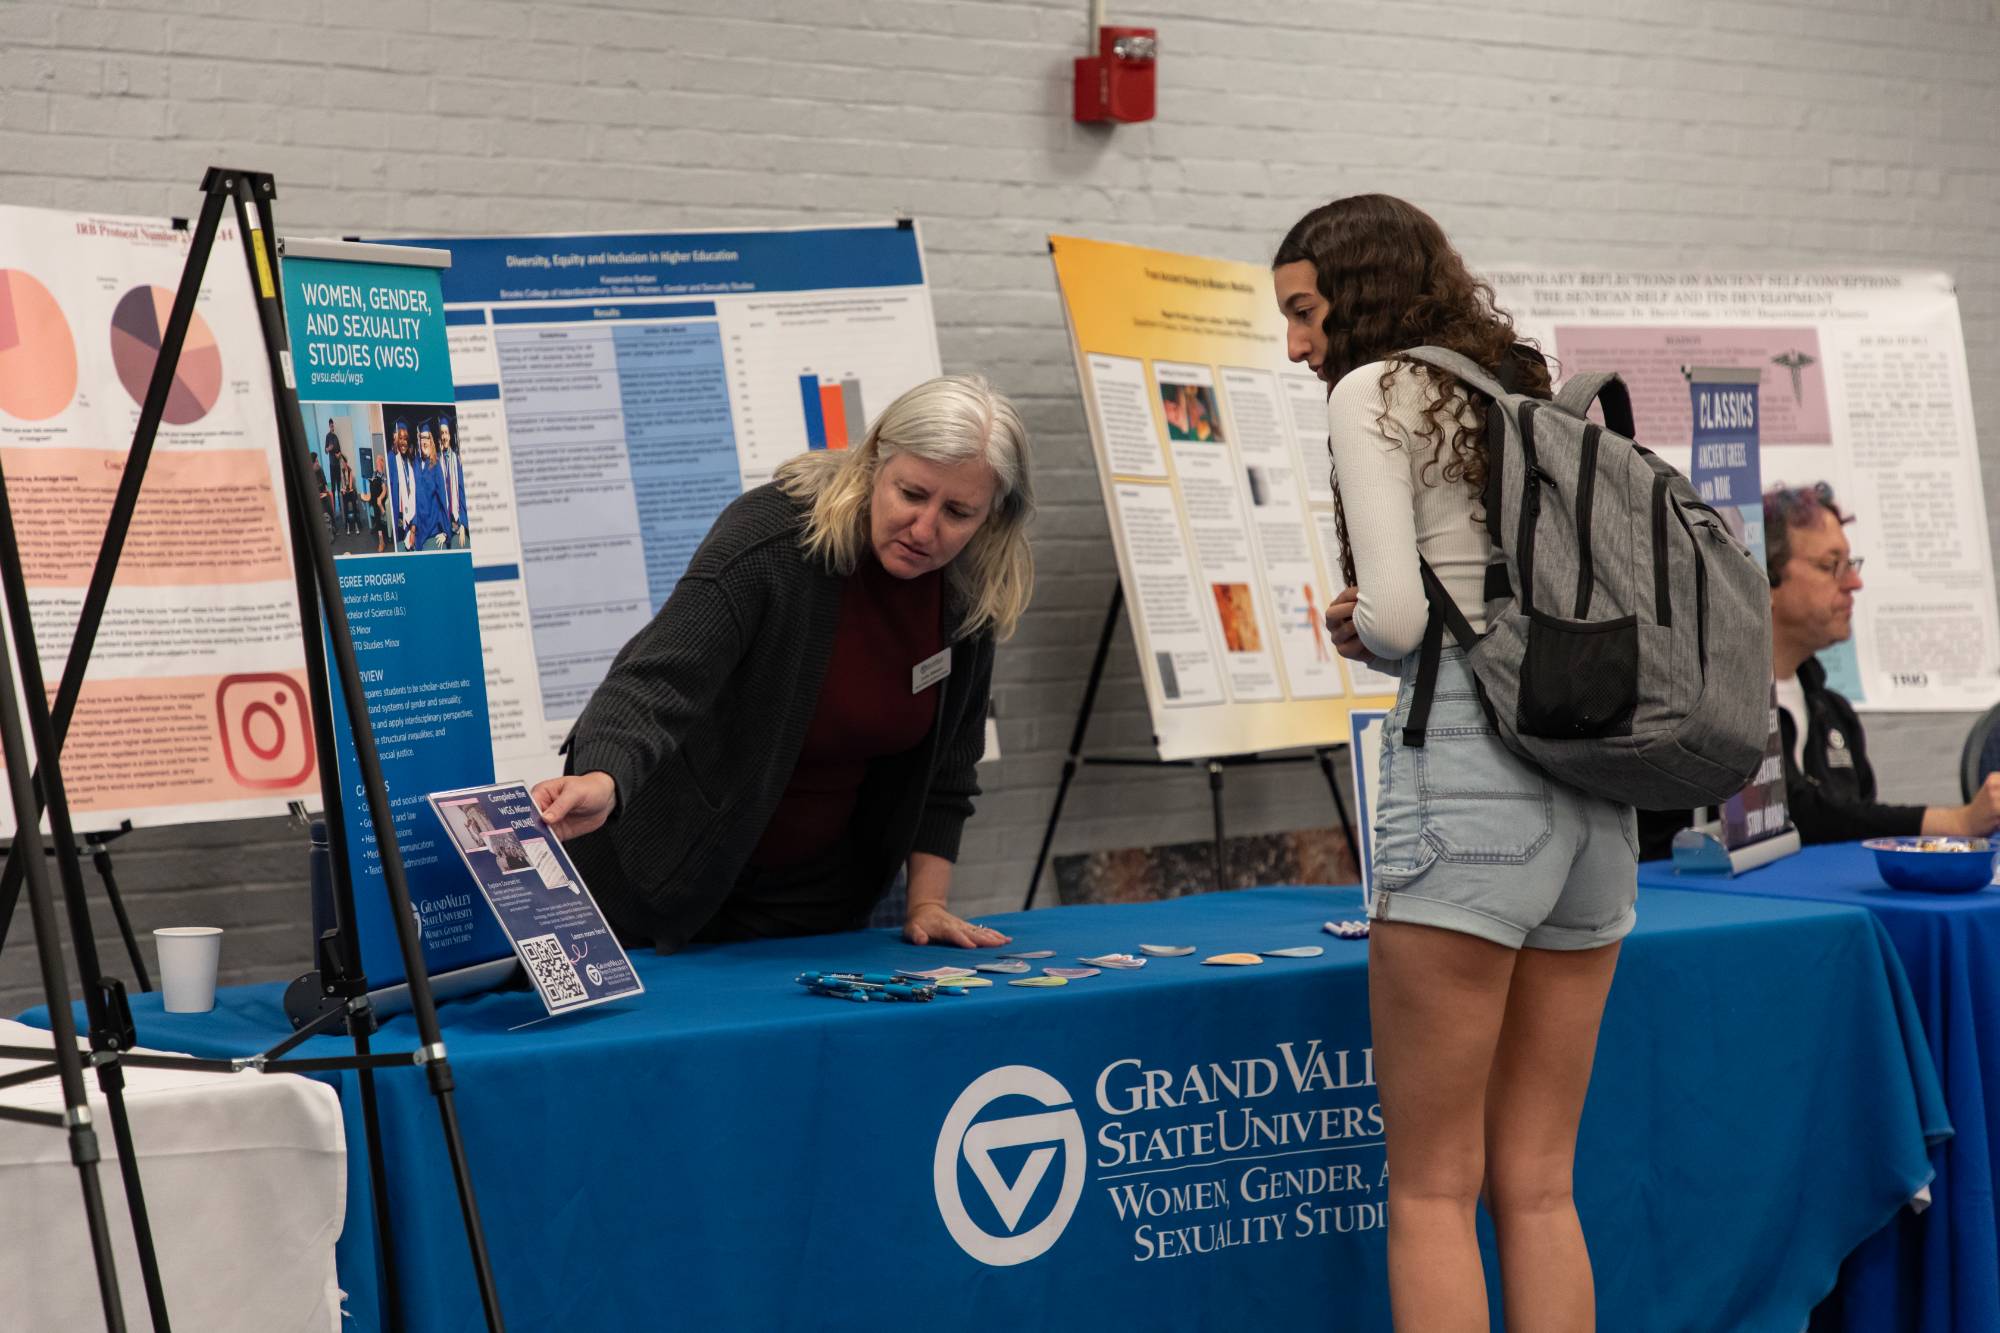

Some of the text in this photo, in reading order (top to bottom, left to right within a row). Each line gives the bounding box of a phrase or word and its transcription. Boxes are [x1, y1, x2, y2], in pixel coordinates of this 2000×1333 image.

[506, 250, 739, 269] Diversity, Equity and Inclusion in Higher Education
[301, 282, 432, 317] WOMEN, GENDER,
[306, 312, 420, 340] AND SEXUALITY
[308, 342, 419, 371] STUDIES (WGS)
[311, 369, 364, 386] gvsu.edu/wgs
[1700, 391, 1754, 430] CLASSICS
[339, 572, 406, 589] EGREE PROGRAMS
[343, 593, 362, 604] achelor
[370, 592, 383, 602] Arts
[370, 606, 393, 618] Science
[356, 625, 371, 635] Minor
[363, 639, 383, 651] Studies
[384, 638, 400, 648] Minor
[359, 669, 384, 683] RVIEW
[383, 686, 406, 696] students
[419, 680, 460, 692] scholar-activists
[381, 702, 404, 714] systems
[410, 699, 427, 711] gender
[427, 697, 438, 707] and
[377, 718, 388, 729] and
[388, 716, 404, 730] apply
[404, 713, 442, 727] interdisciplinary
[381, 732, 407, 745] structural
[435, 727, 446, 738] and
[379, 749, 396, 761] social
[390, 795, 417, 808] and social
[488, 790, 527, 803] Complete the
[396, 812, 407, 823] and
[498, 805, 531, 815] WGS Minor
[421, 894, 471, 914] GRAND VALLEY
[421, 908, 472, 927] STATE UNIVERSITY
[571, 932, 584, 940] Learn
[1095, 1039, 1377, 1116] GRAND VALL
[1097, 1103, 1386, 1168] STATE UNIVERS
[1107, 1178, 1230, 1222] WOMEN,
[1239, 1165, 1373, 1203] GENDER,
[1133, 1200, 1389, 1263] SEXUALITY STUDI
